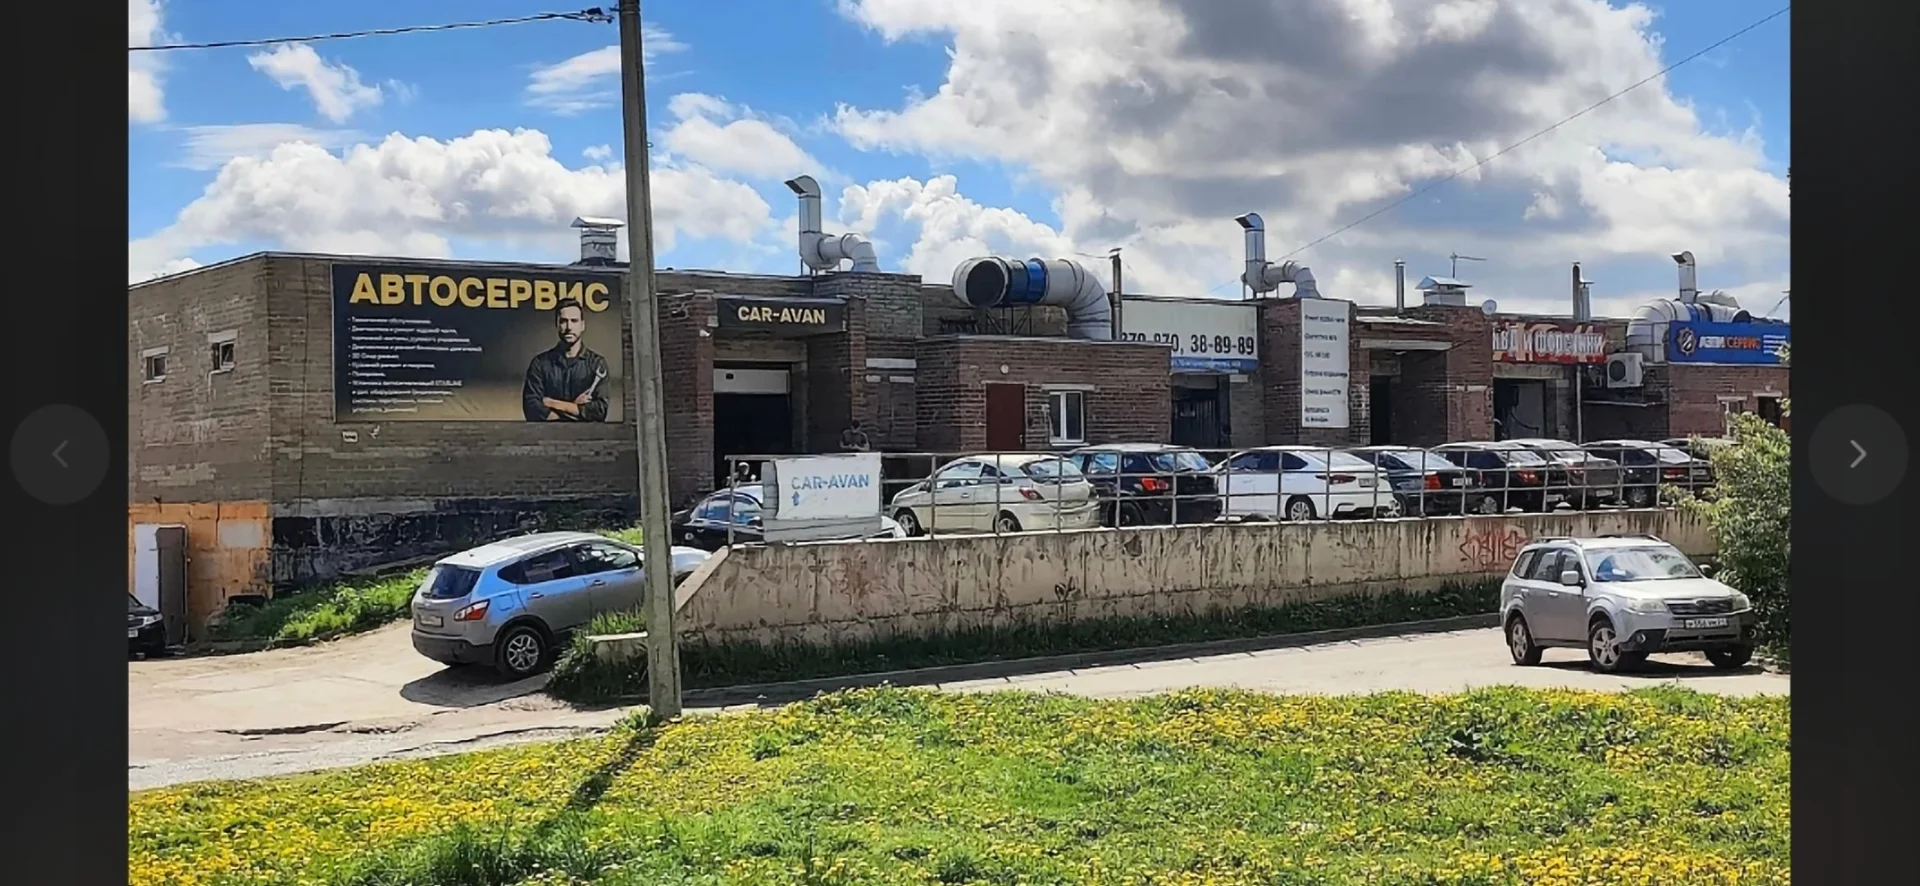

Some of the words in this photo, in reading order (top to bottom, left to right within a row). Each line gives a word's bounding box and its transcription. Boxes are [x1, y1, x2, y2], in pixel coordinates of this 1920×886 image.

[350, 272, 610, 313] АВТОСЕРВИС
[737, 305, 826, 325] CAR-AVAN
[1190, 334, 1255, 355] 38-89-89
[791, 474, 870, 490] CAR-AVAN
